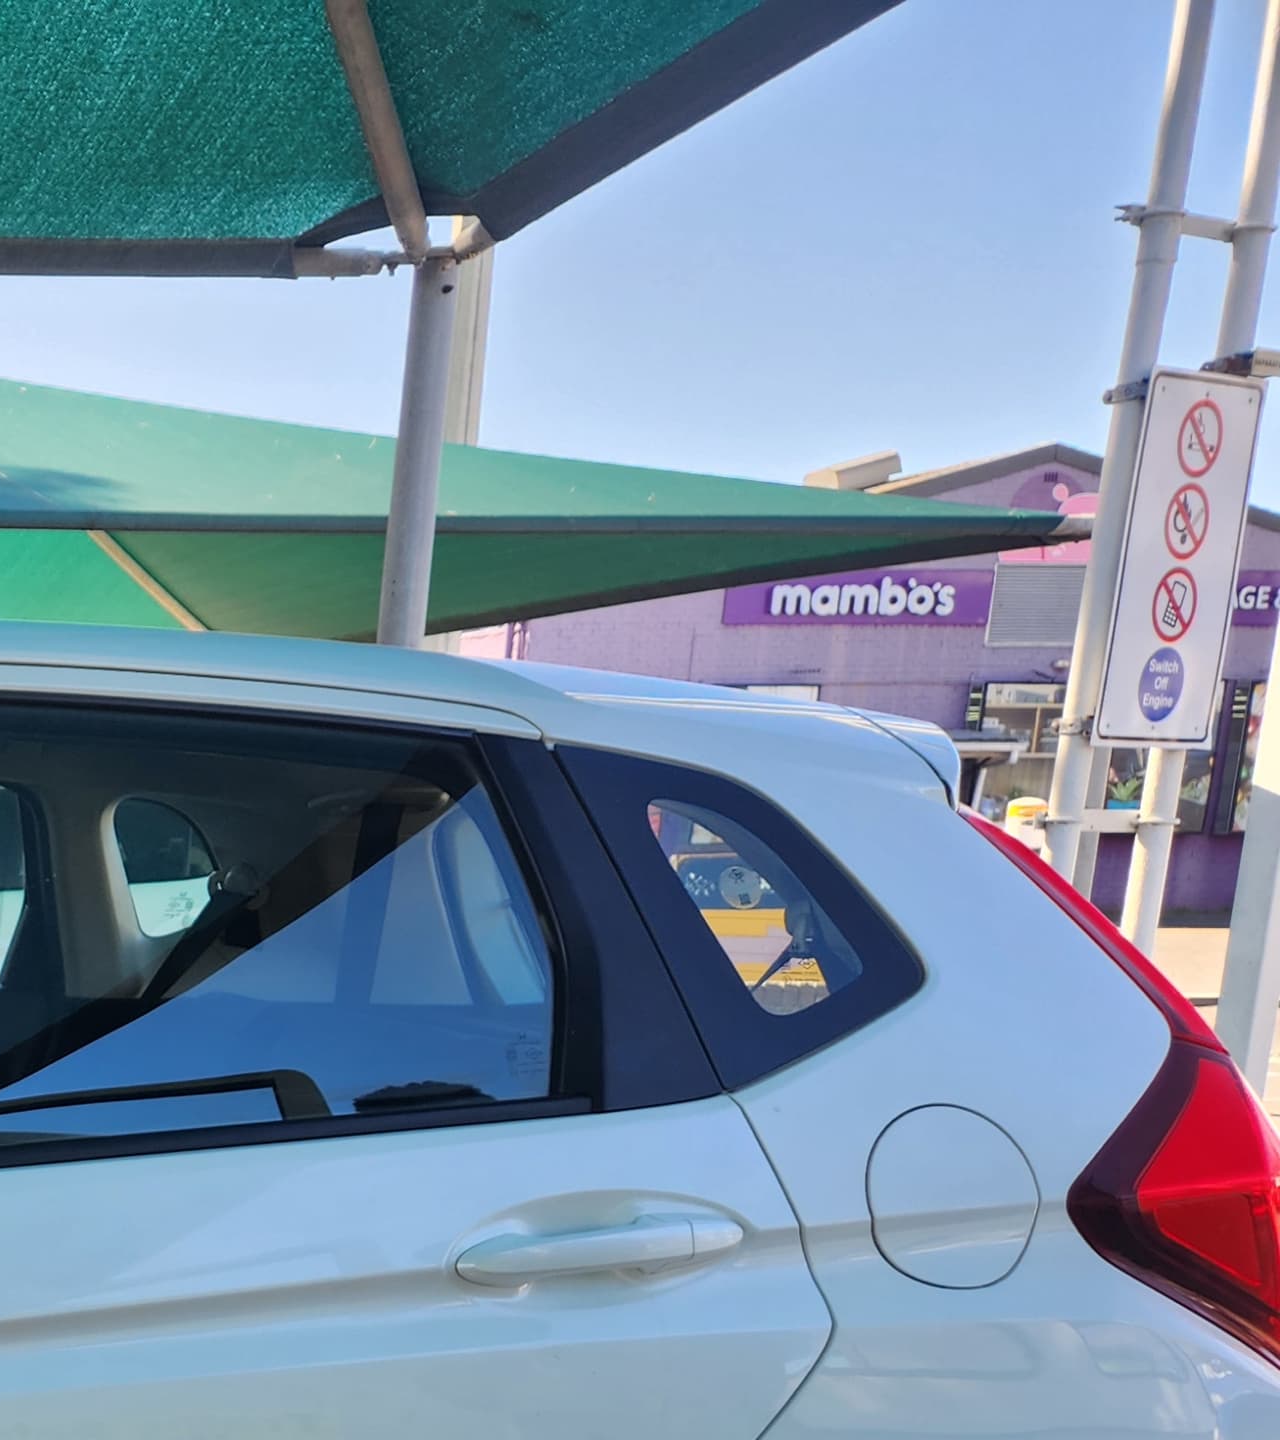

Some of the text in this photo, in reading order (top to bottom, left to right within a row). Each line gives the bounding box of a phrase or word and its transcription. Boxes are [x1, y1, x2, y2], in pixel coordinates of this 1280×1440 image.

[770, 576, 956, 616] mambo's
[1149, 658, 1179, 673] Switch
[1154, 676, 1169, 690] Off
[1143, 692, 1173, 710] Engine
